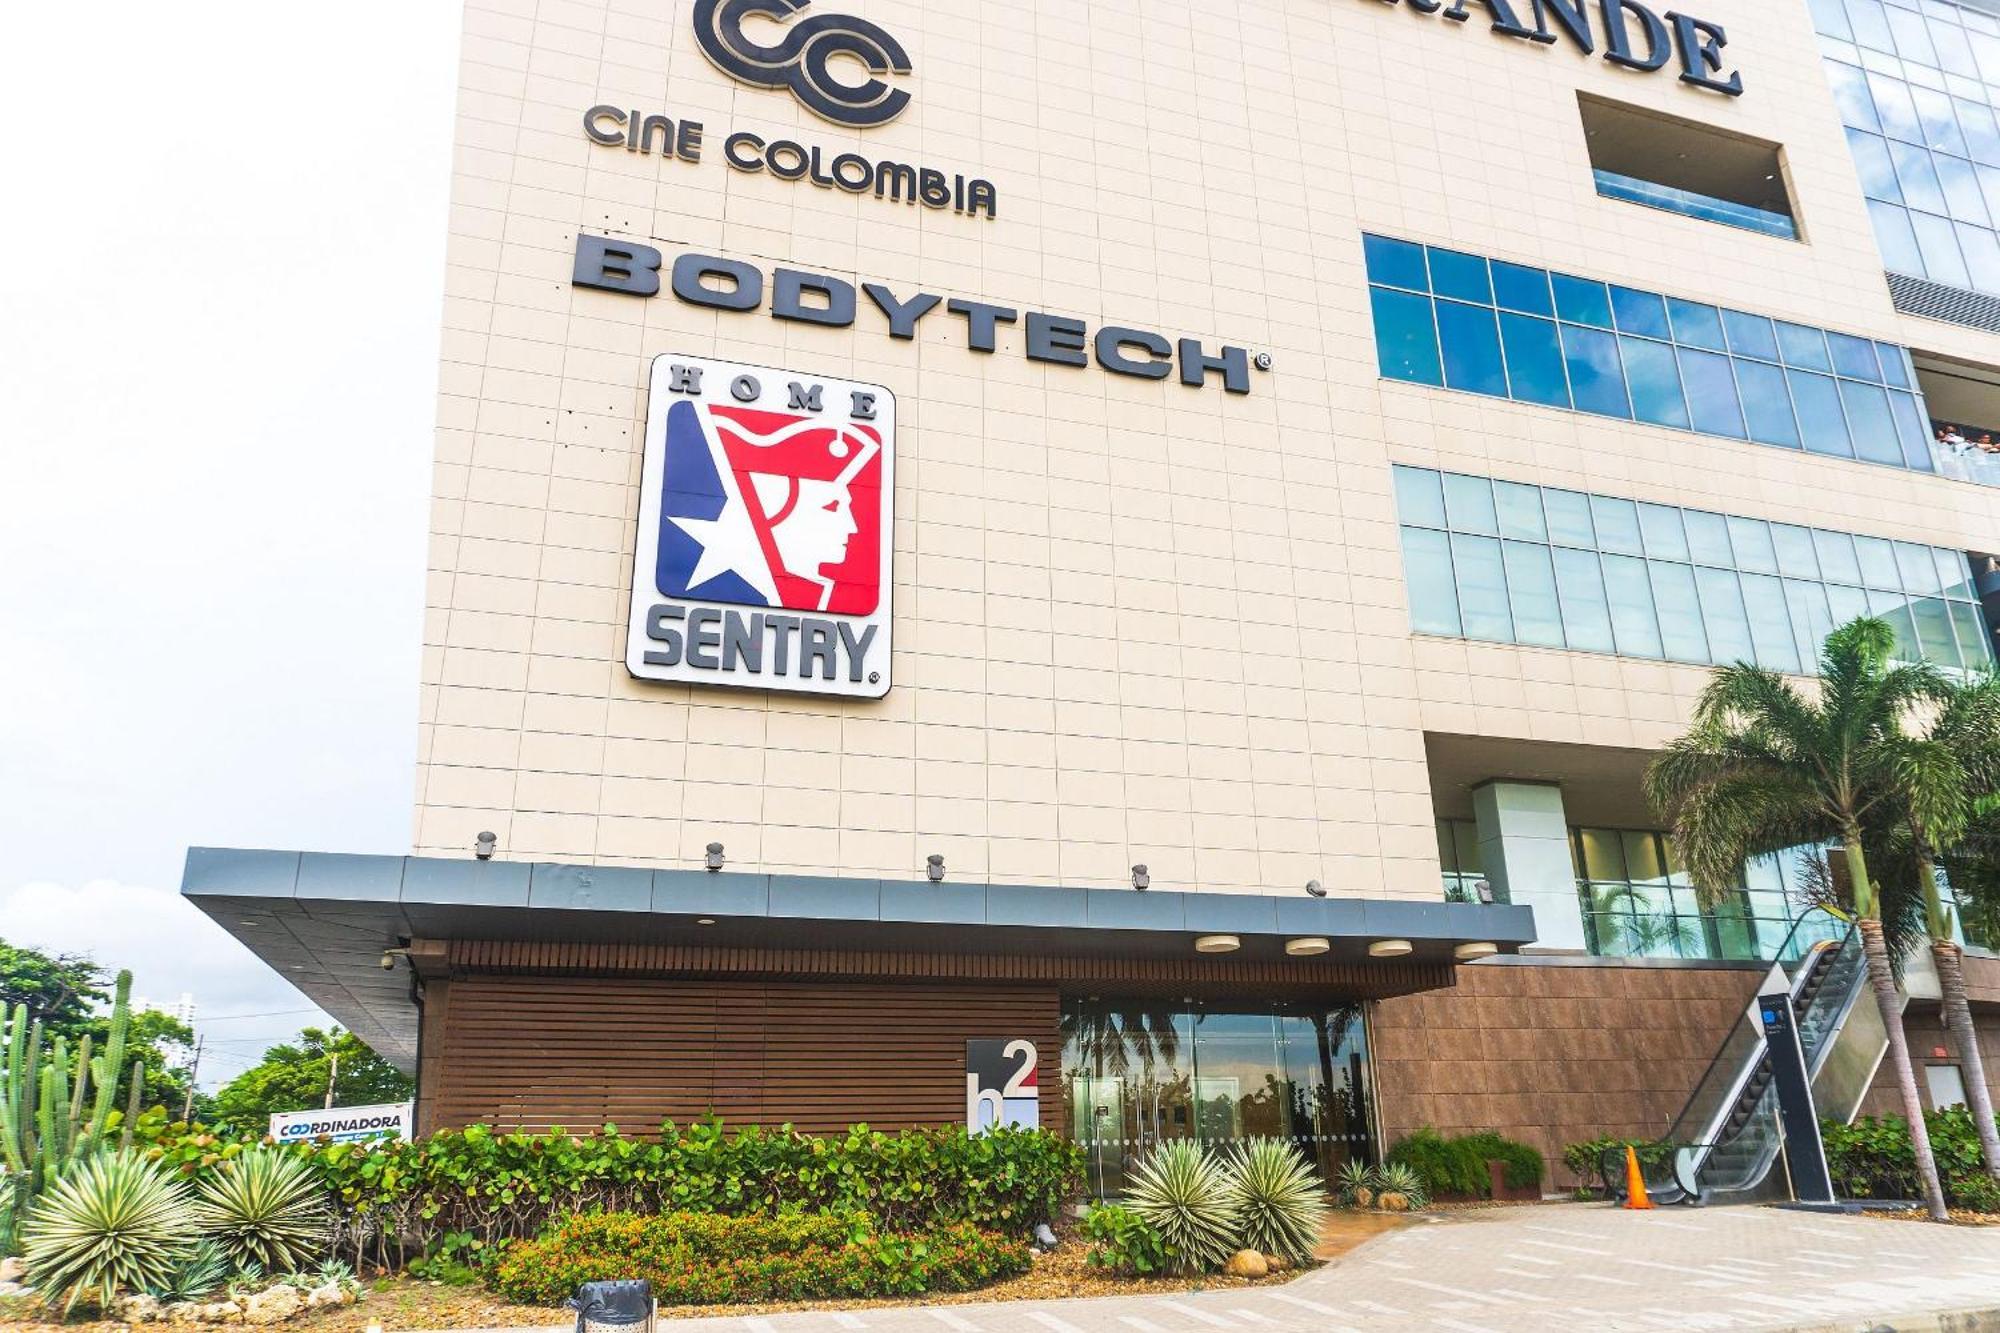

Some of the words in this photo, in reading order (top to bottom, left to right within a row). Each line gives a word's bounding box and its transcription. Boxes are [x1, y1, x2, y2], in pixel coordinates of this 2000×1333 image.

[1385, 0, 1744, 97] NDE
[583, 105, 703, 162] CINE
[724, 132, 997, 219] COLOMBIA
[669, 364, 878, 420] HOME
[280, 1115, 401, 1137] COORDINADORA
